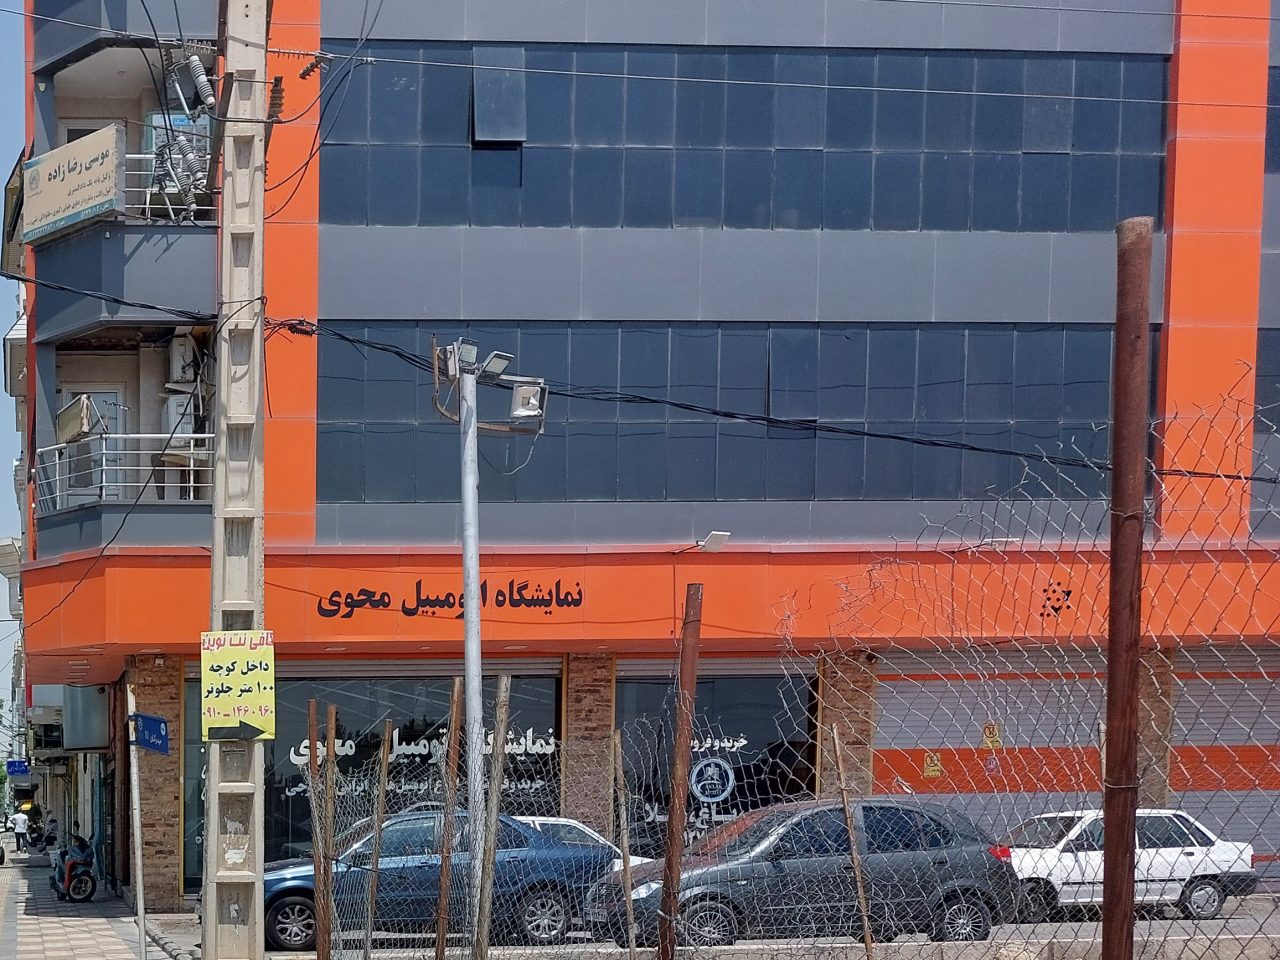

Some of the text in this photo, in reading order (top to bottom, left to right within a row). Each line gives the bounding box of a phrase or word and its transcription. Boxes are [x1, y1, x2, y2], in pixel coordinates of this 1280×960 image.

[47, 149, 110, 182] موسی رضا زاده
[317, 588, 391, 618] محوی
[495, 578, 583, 615] نمایشگاه
[208, 660, 269, 677] داخل کوچه
[203, 680, 274, 699] ۱۰۰ متر جلوتر
[712, 738, 720, 751] و
[720, 732, 748, 752] خرید
